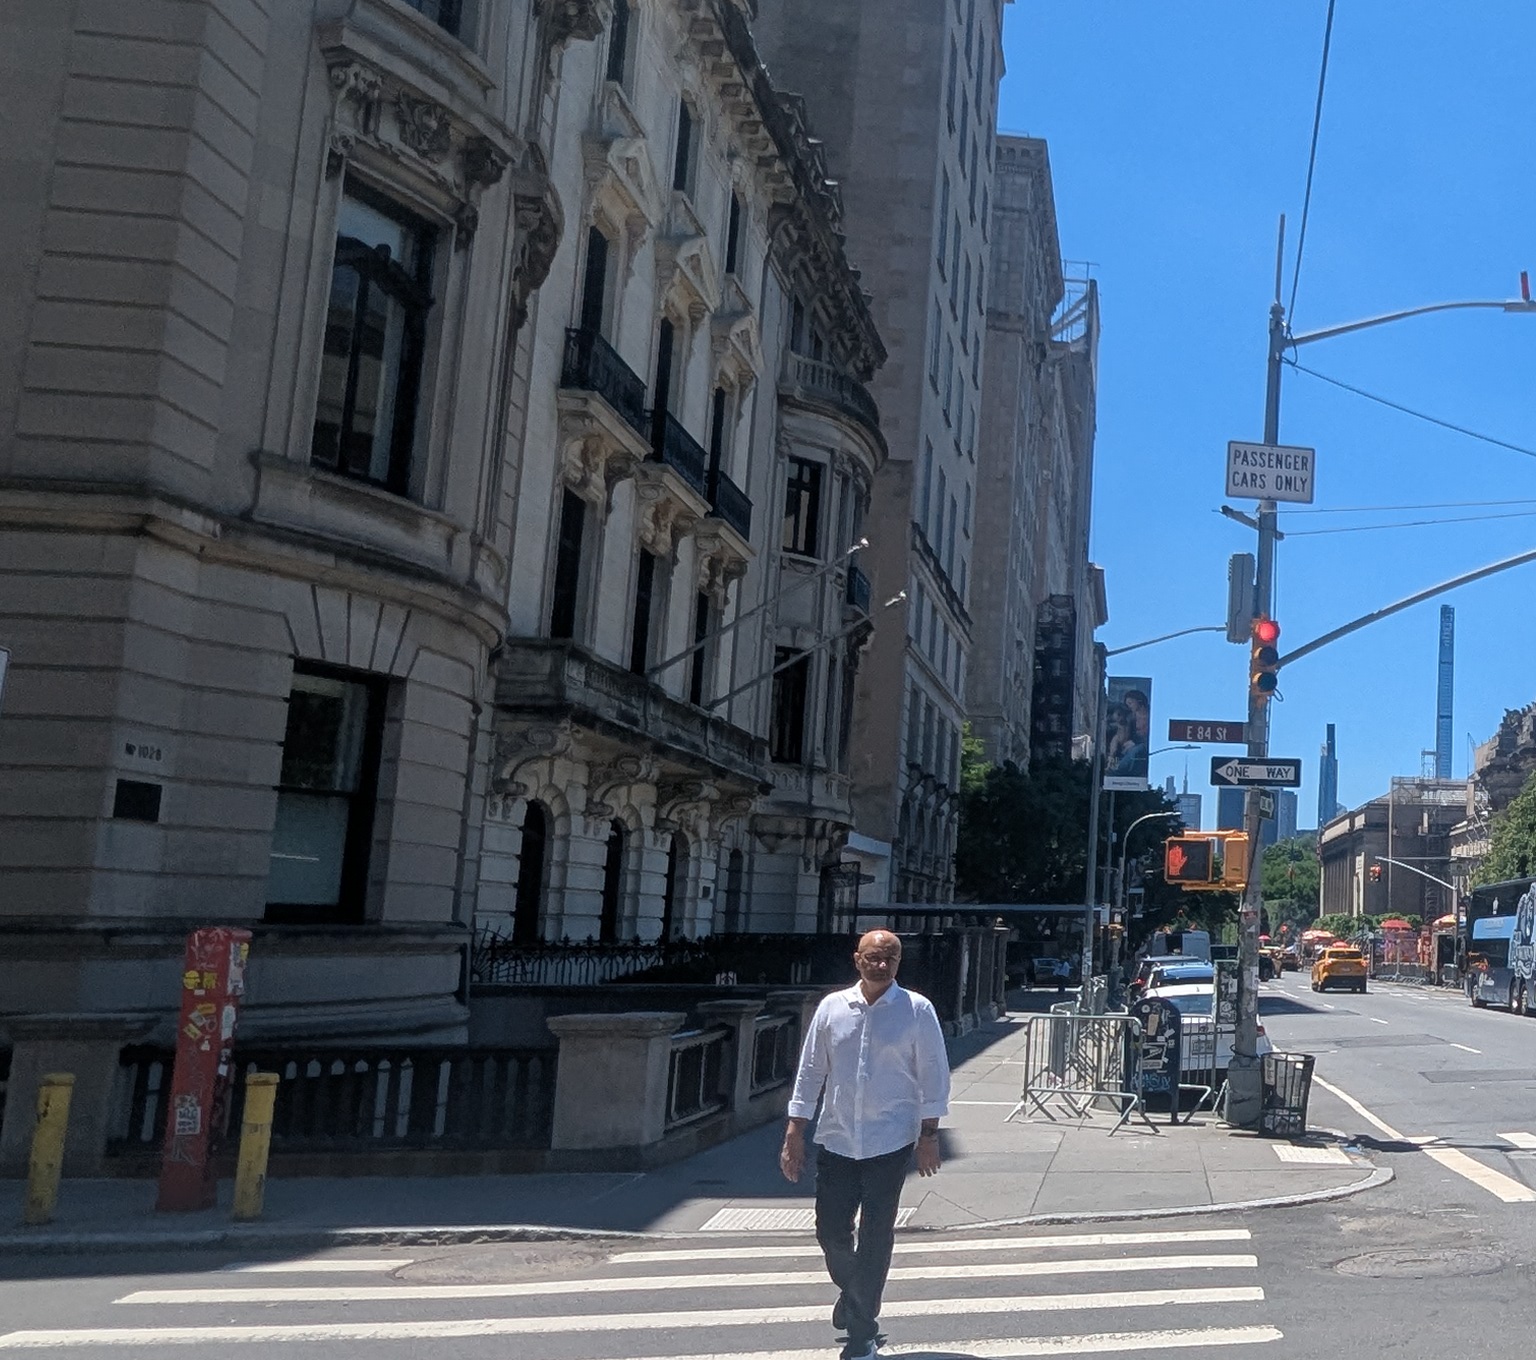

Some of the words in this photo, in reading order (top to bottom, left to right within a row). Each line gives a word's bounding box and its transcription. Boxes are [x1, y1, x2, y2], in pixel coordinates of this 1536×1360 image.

[1233, 449, 1309, 471] PASSENGER
[1232, 471, 1266, 489] CARS
[1275, 475, 1308, 493] ONLY
[1186, 726, 1193, 740] E
[1196, 726, 1212, 740] 84
[1215, 727, 1227, 741] St
[1225, 766, 1249, 778] ONE
[1266, 767, 1291, 778] WAY
